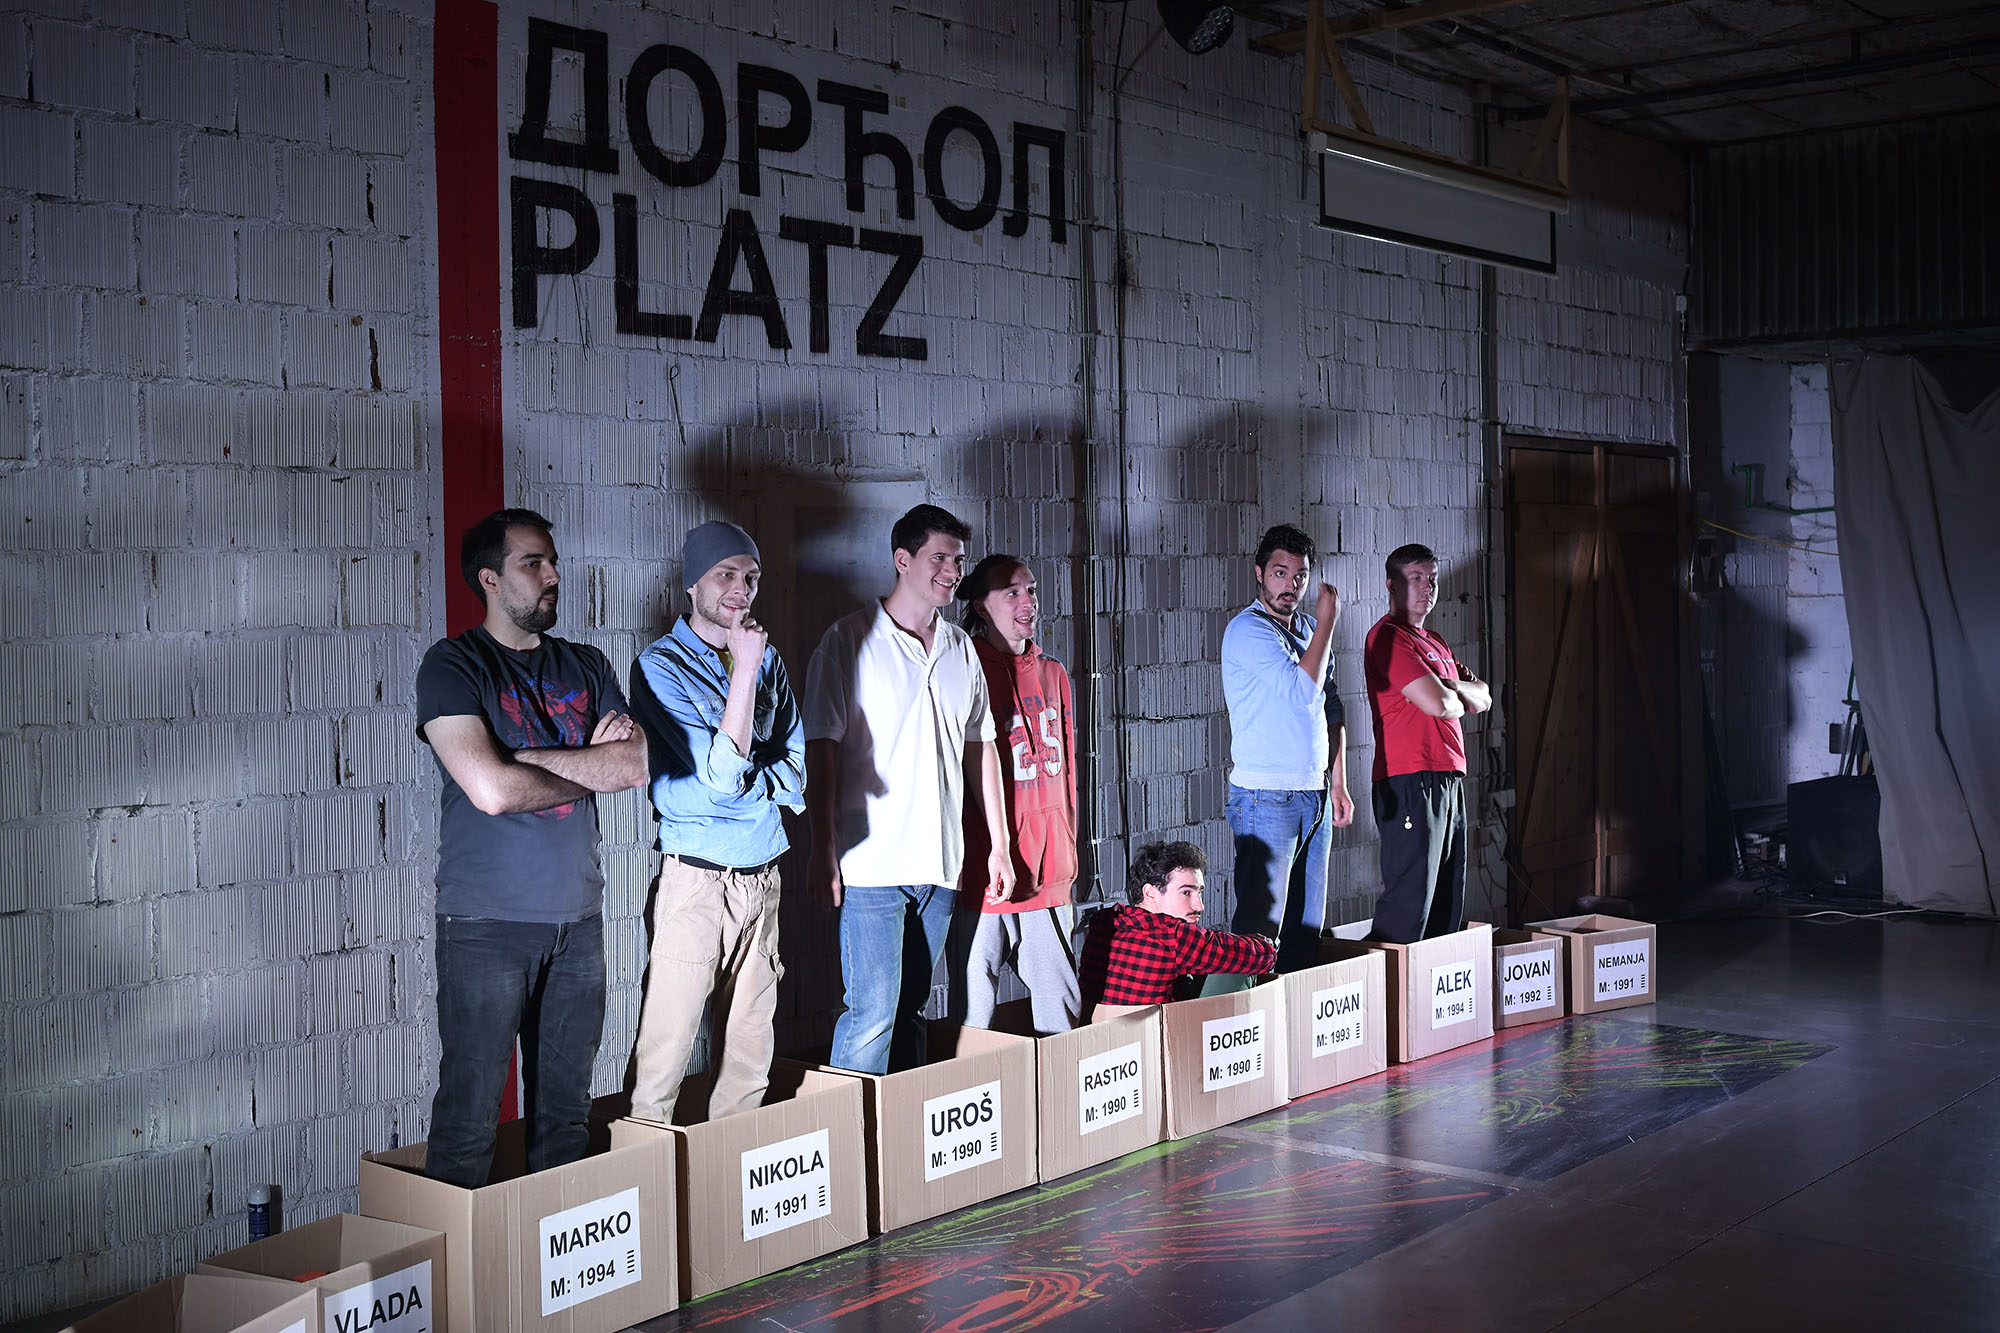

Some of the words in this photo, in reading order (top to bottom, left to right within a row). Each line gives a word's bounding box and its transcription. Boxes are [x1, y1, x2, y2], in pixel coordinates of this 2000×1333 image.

[508, 16, 1067, 244] ДОРЋОЛ
[510, 176, 927, 360] PLATZ
[1504, 960, 1551, 982] JOVAN
[1598, 952, 1645, 969] NEMANJA
[1435, 969, 1472, 996] ALEK
[1598, 981, 1610, 993] M:
[1613, 977, 1634, 991] 1991
[1316, 993, 1360, 1020] JOVAN
[1435, 1007, 1445, 1020] M:
[1447, 1002, 1465, 1017] 1994
[1504, 994, 1516, 1006] M:
[1519, 989, 1541, 1004] 1992
[1209, 1025, 1260, 1052] ĐORĐE
[1316, 1033, 1328, 1048] M:
[1330, 1027, 1351, 1044] 1993
[1084, 1060, 1138, 1092] RASTKO
[1209, 1066, 1223, 1081] M:
[1226, 1059, 1251, 1077] 1990
[931, 1091, 994, 1137] UROŠ
[1085, 1106, 1098, 1123] M:
[1101, 1096, 1127, 1116] 1990
[931, 1150, 947, 1169] M:
[951, 1139, 982, 1162] 1990
[749, 1150, 825, 1190] NIKOLA
[750, 1207, 769, 1227] M:
[774, 1193, 807, 1219] 1991
[549, 1210, 632, 1259] MARKO
[550, 1276, 571, 1299] M:
[577, 1259, 616, 1289] 1994
[333, 1285, 423, 1333] VLADA
